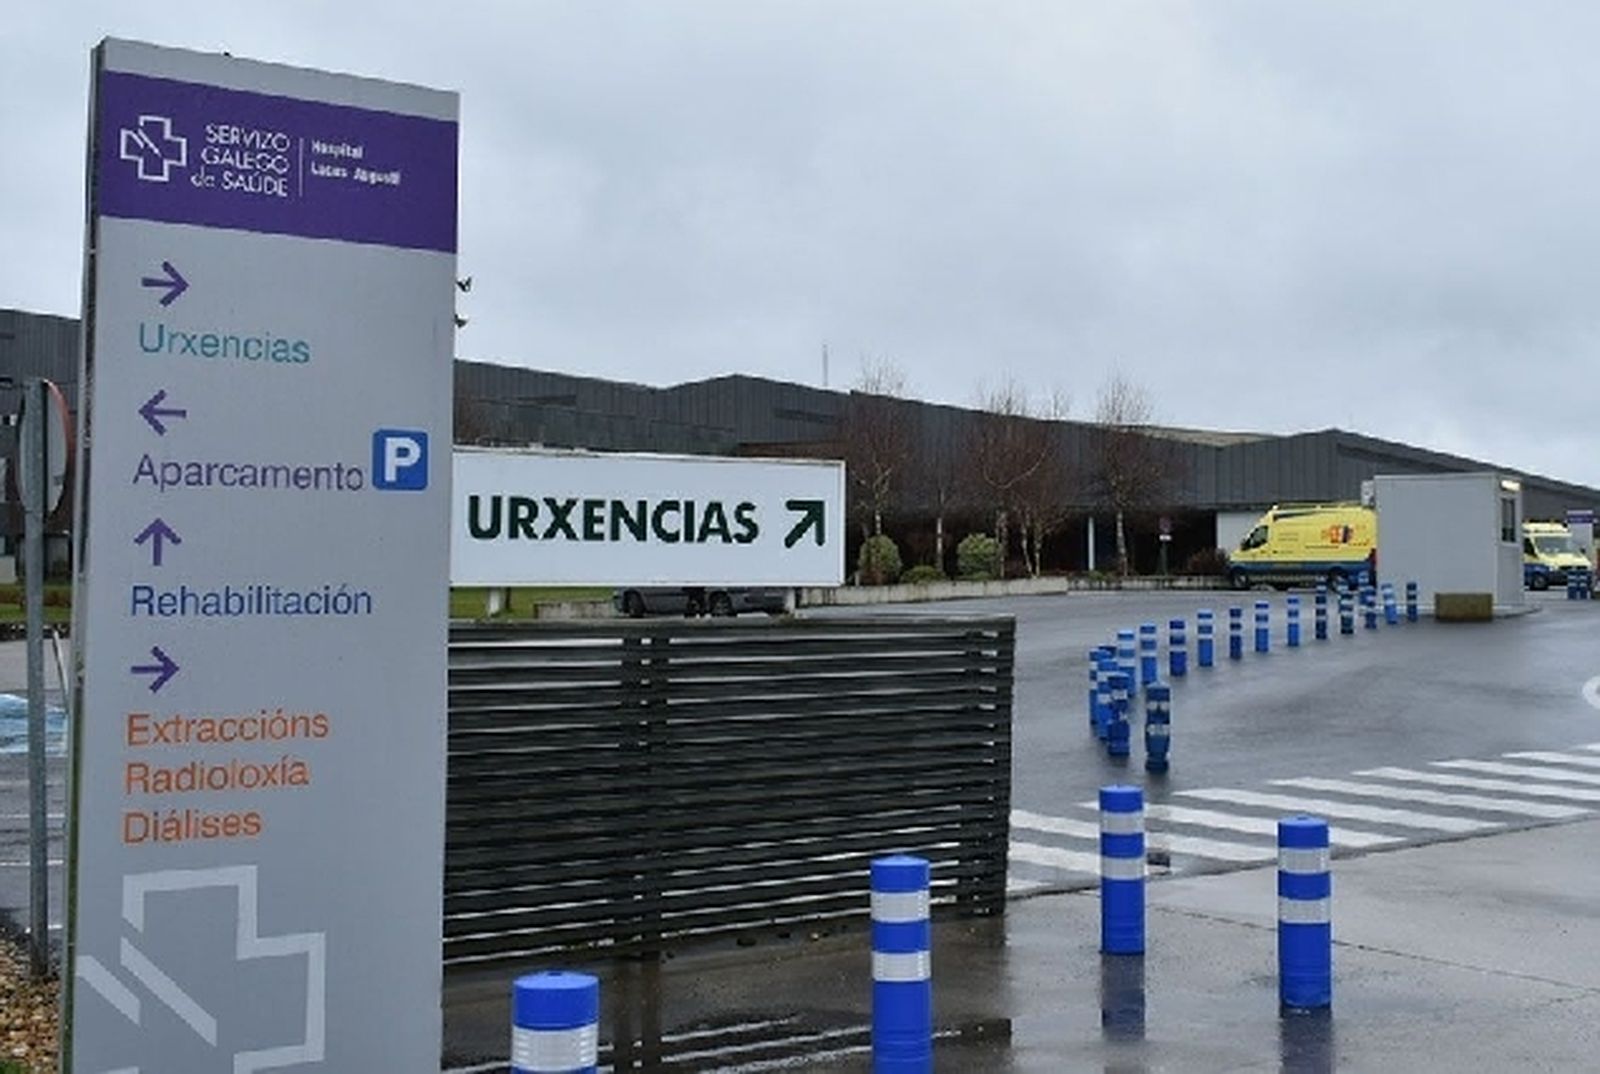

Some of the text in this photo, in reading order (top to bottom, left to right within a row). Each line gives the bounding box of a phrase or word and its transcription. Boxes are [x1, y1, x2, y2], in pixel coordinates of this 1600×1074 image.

[205, 123, 290, 152] SERVIZO
[201, 146, 290, 174] GALEGO
[190, 167, 288, 197] de SAÚDE
[138, 322, 311, 364] Urxencias
[132, 453, 365, 492] Aparcamento
[384, 437, 422, 483] P
[468, 494, 760, 545] URXENCIAS
[131, 584, 373, 617] Rehabilitación
[126, 709, 330, 747] Extraccións
[124, 754, 310, 796] Radioloxía
[122, 808, 263, 845] Diálises
